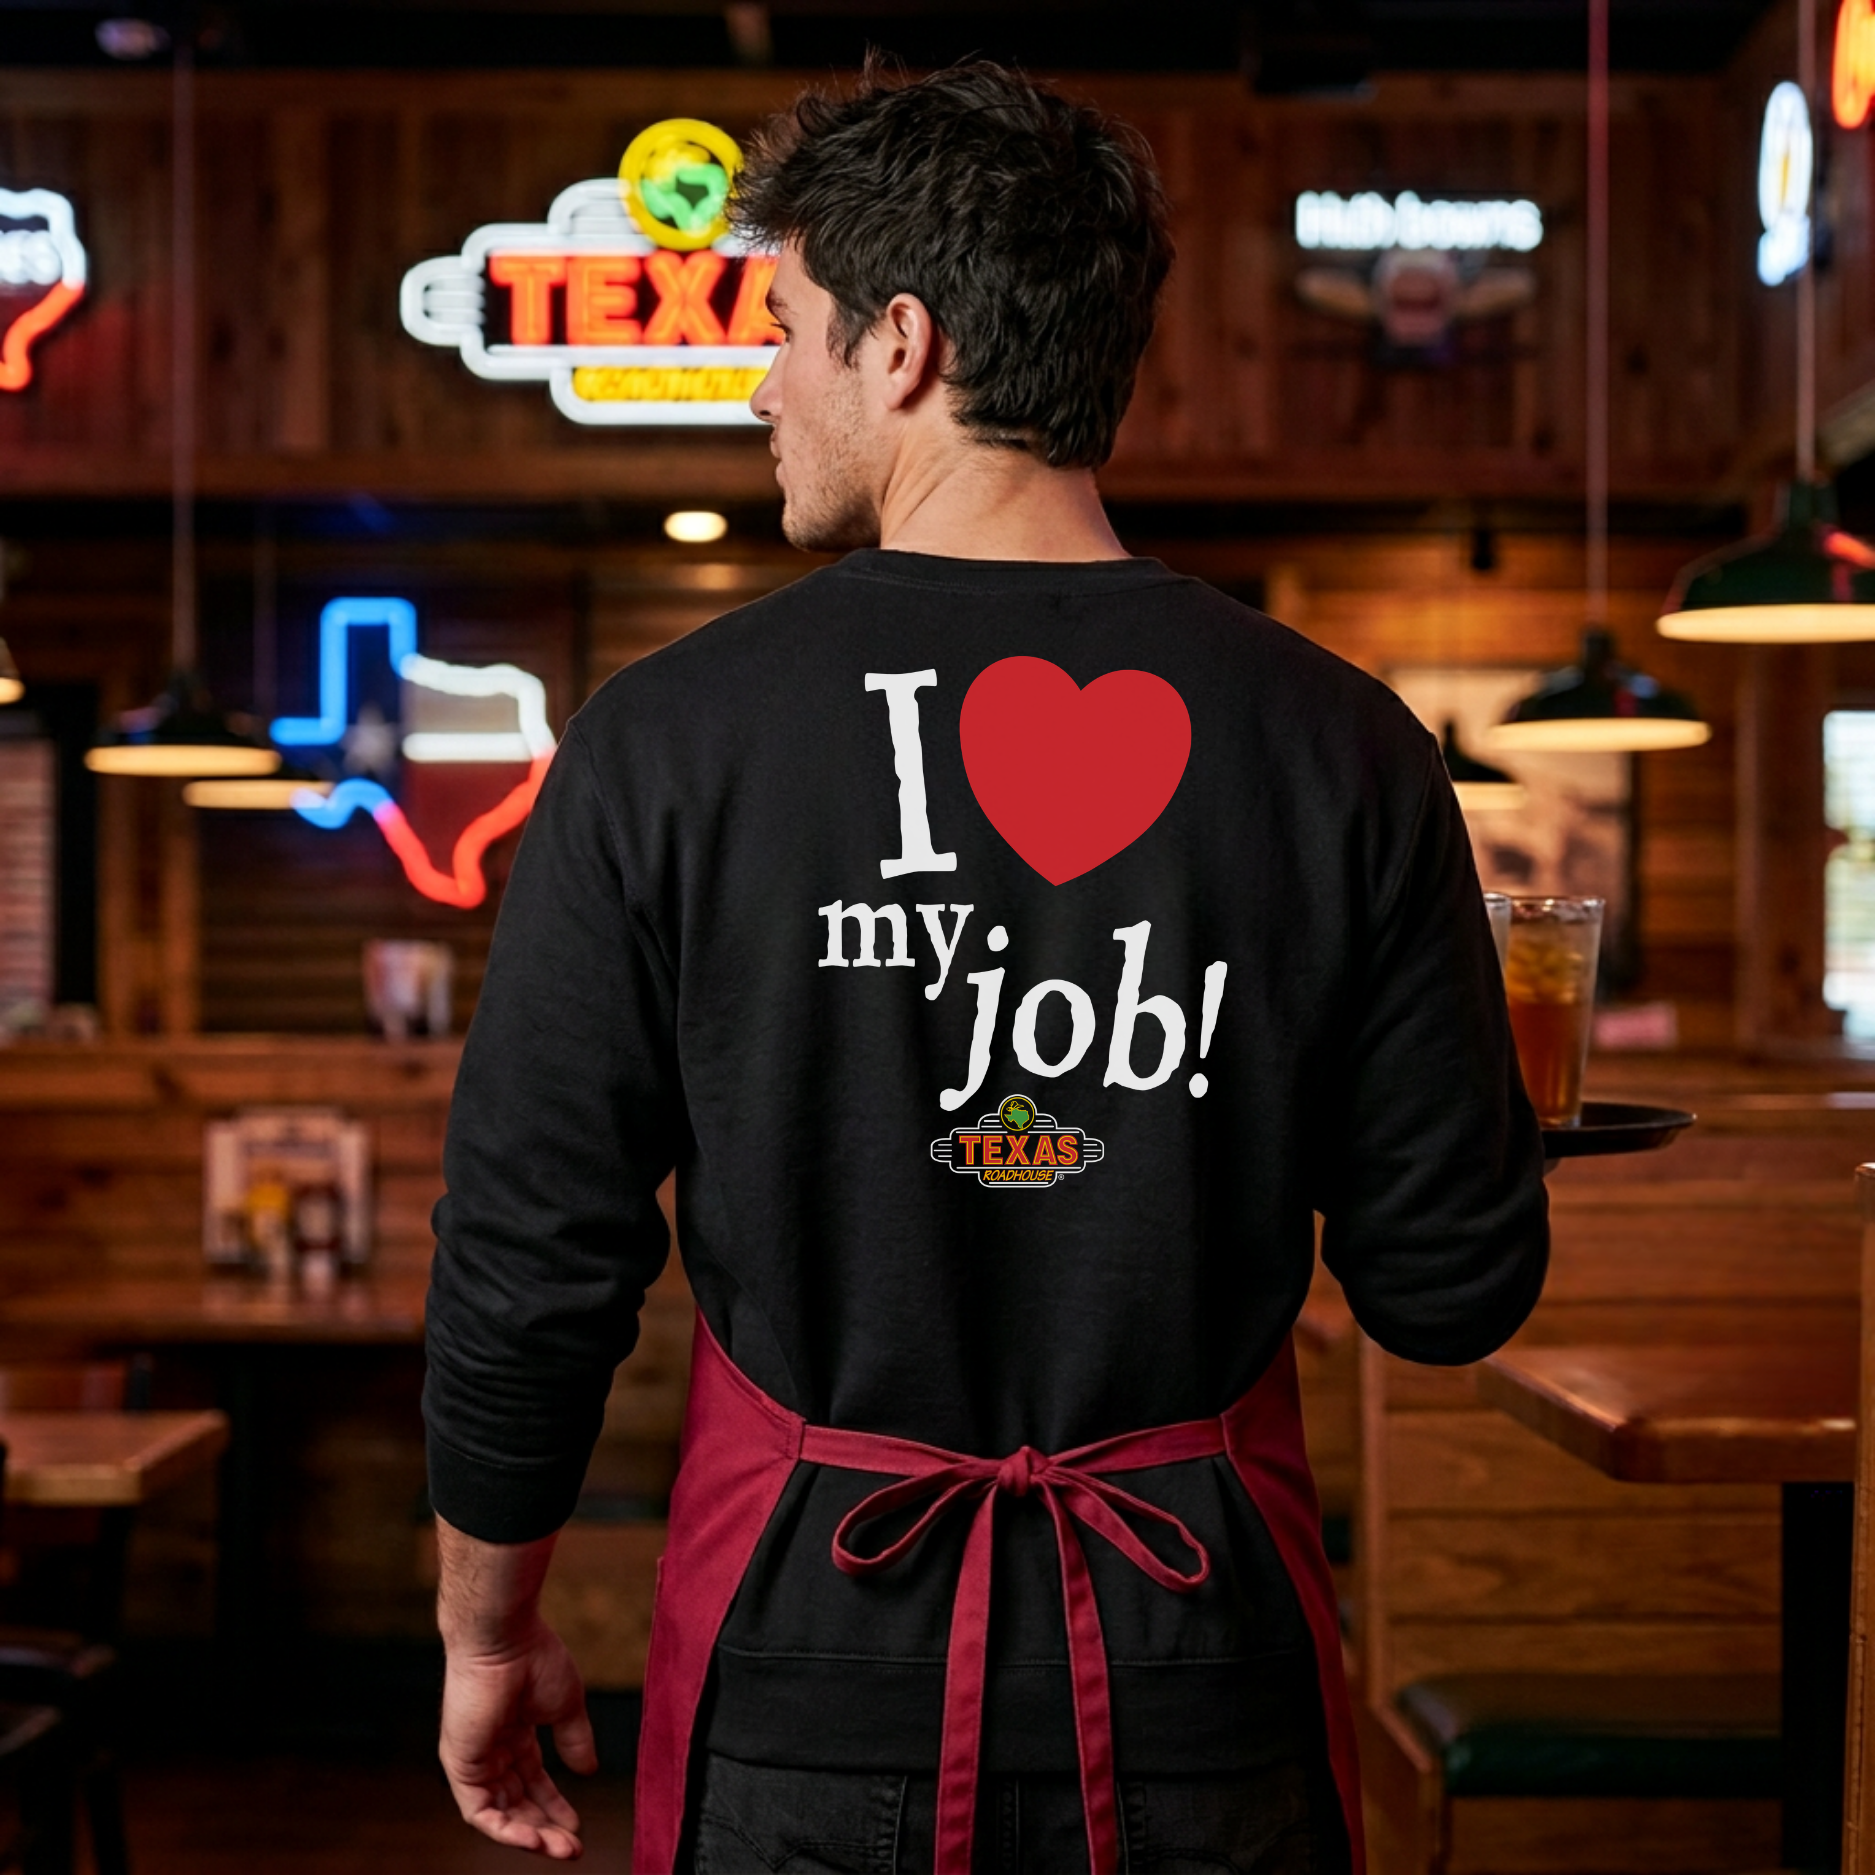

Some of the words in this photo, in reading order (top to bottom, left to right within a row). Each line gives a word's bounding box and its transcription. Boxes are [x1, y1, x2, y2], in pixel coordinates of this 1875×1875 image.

[865, 669, 957, 879] I
[819, 900, 974, 1000] my
[940, 920, 1228, 1111] job!
[958, 1134, 1079, 1166] TEXAS
[983, 1169, 1054, 1182] ROADHOUSE
